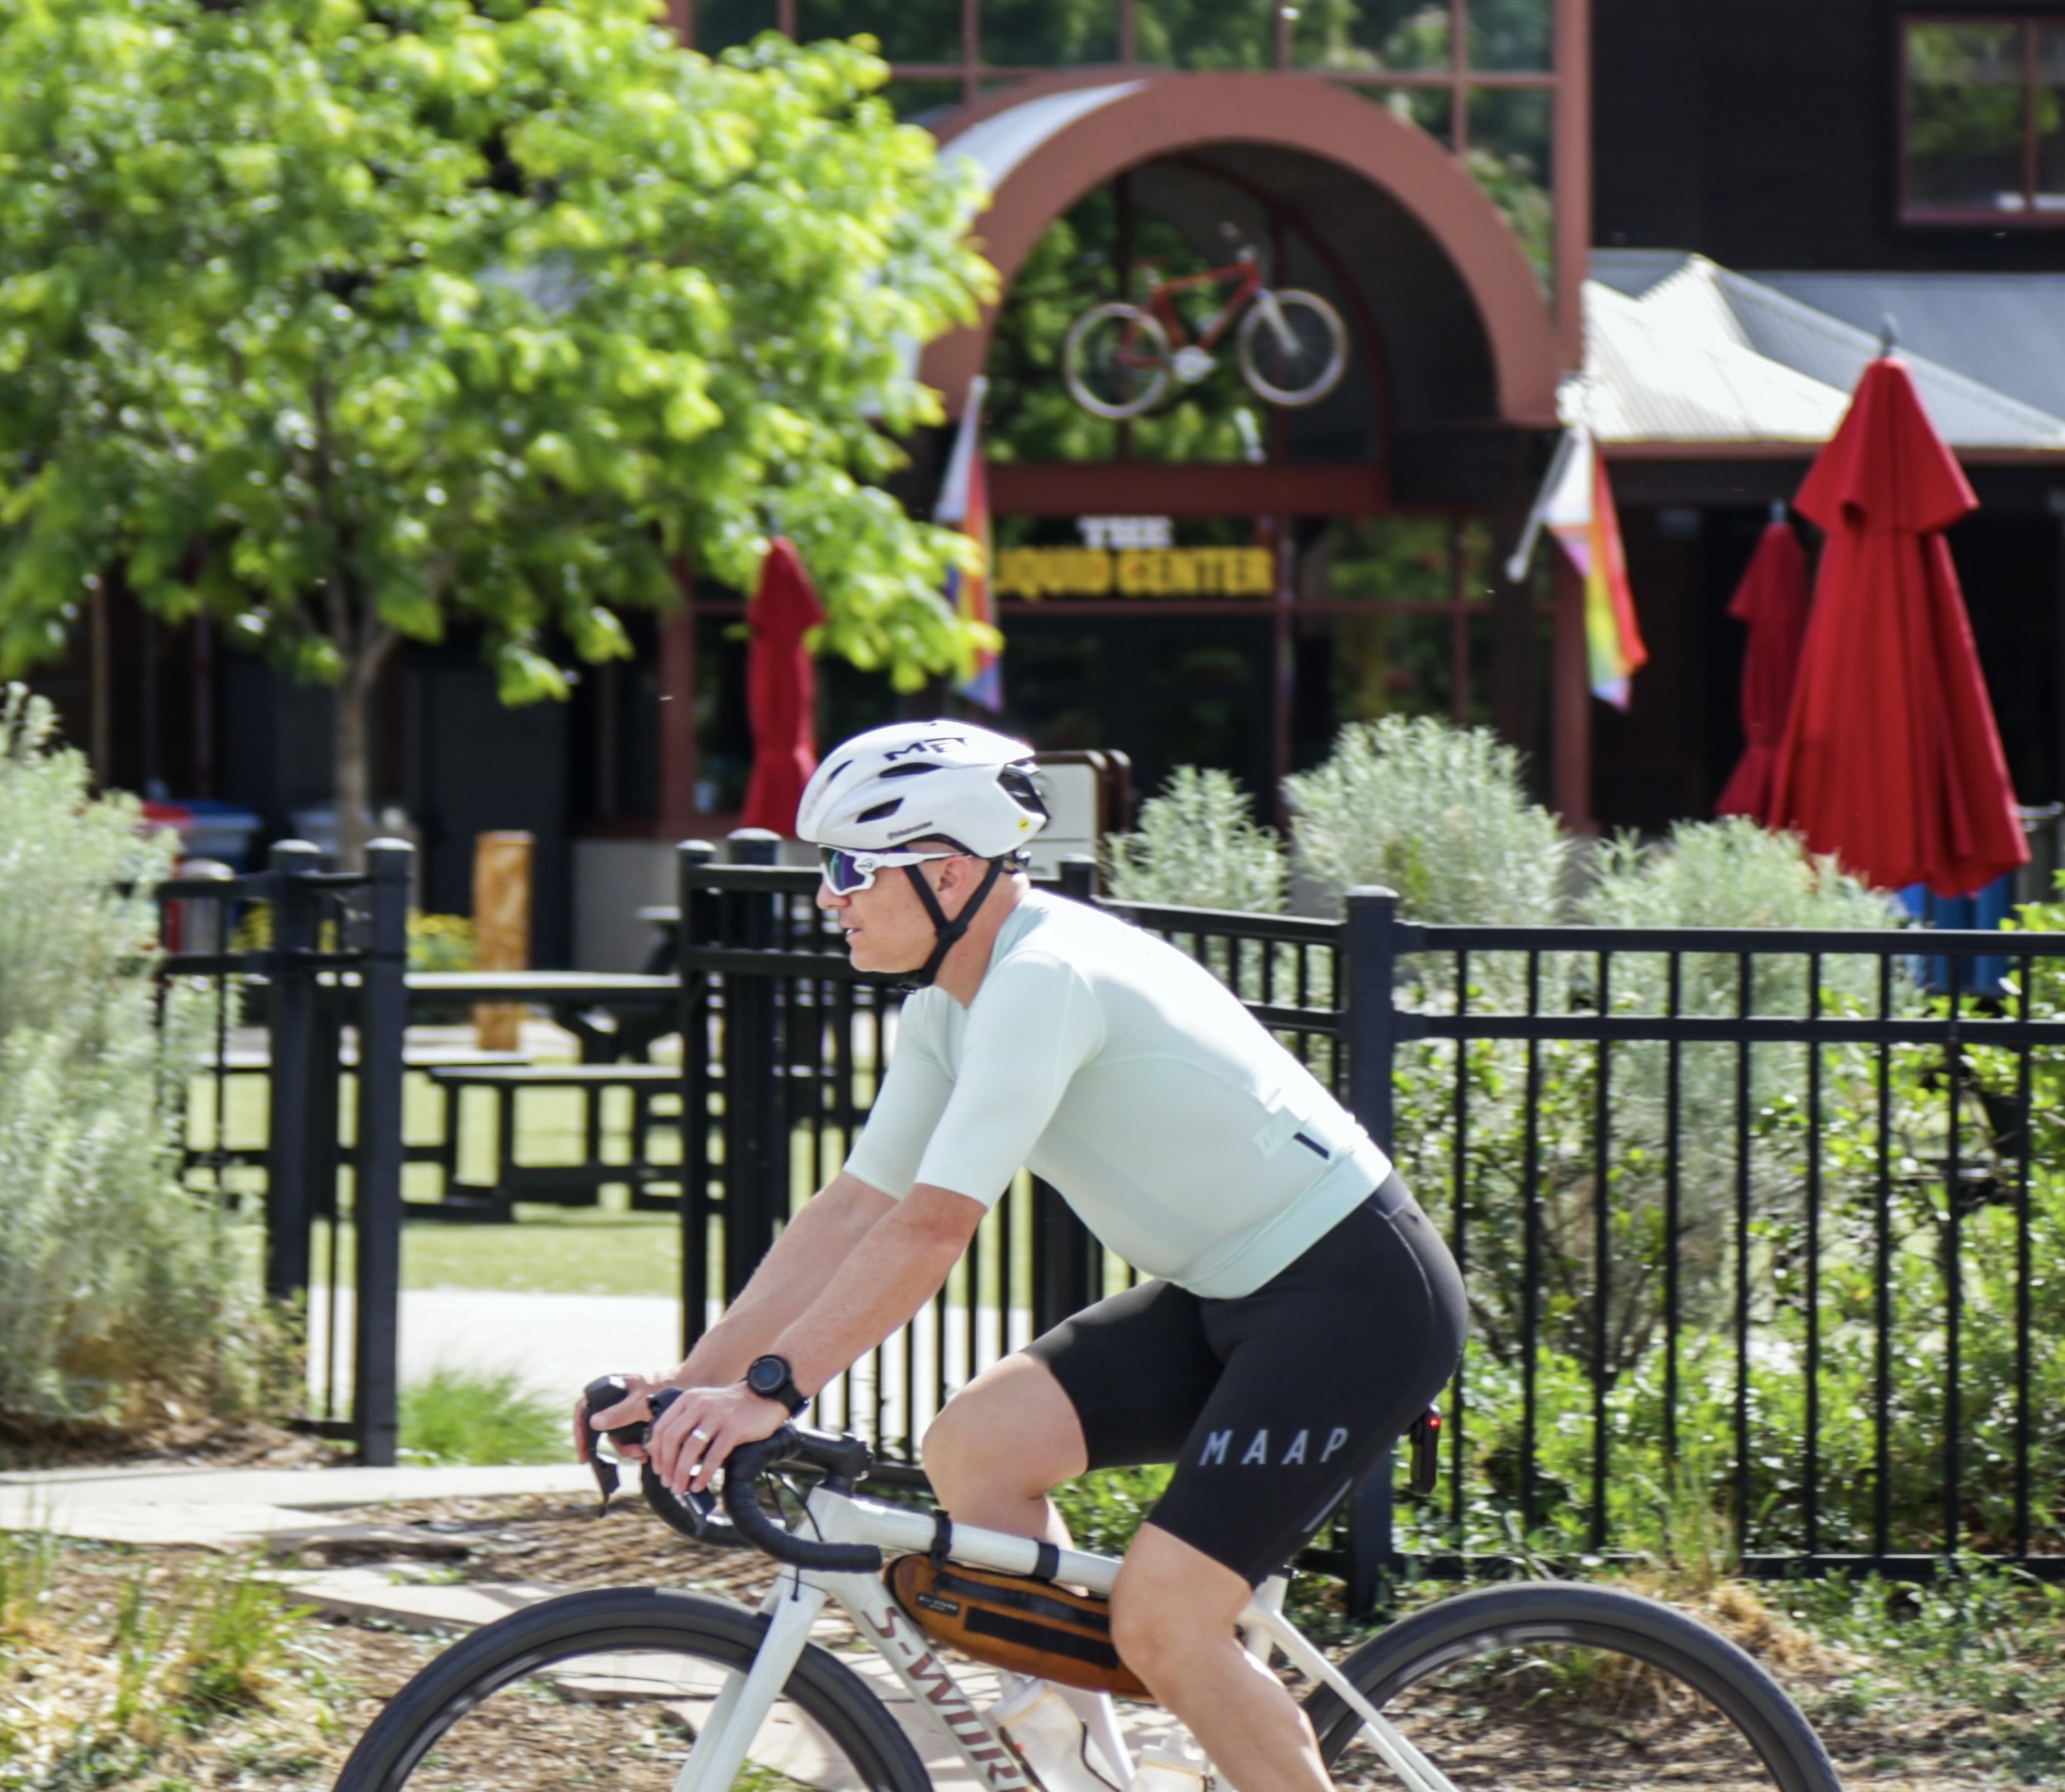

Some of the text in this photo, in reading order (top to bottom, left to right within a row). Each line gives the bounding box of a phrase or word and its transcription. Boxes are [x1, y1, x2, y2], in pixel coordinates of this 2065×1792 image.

[1077, 516, 1173, 548] THE
[996, 546, 1273, 602] IQUID CENTER
[1199, 1427, 1349, 1466] MAAP
[862, 1606, 1033, 1792] S-WOR
